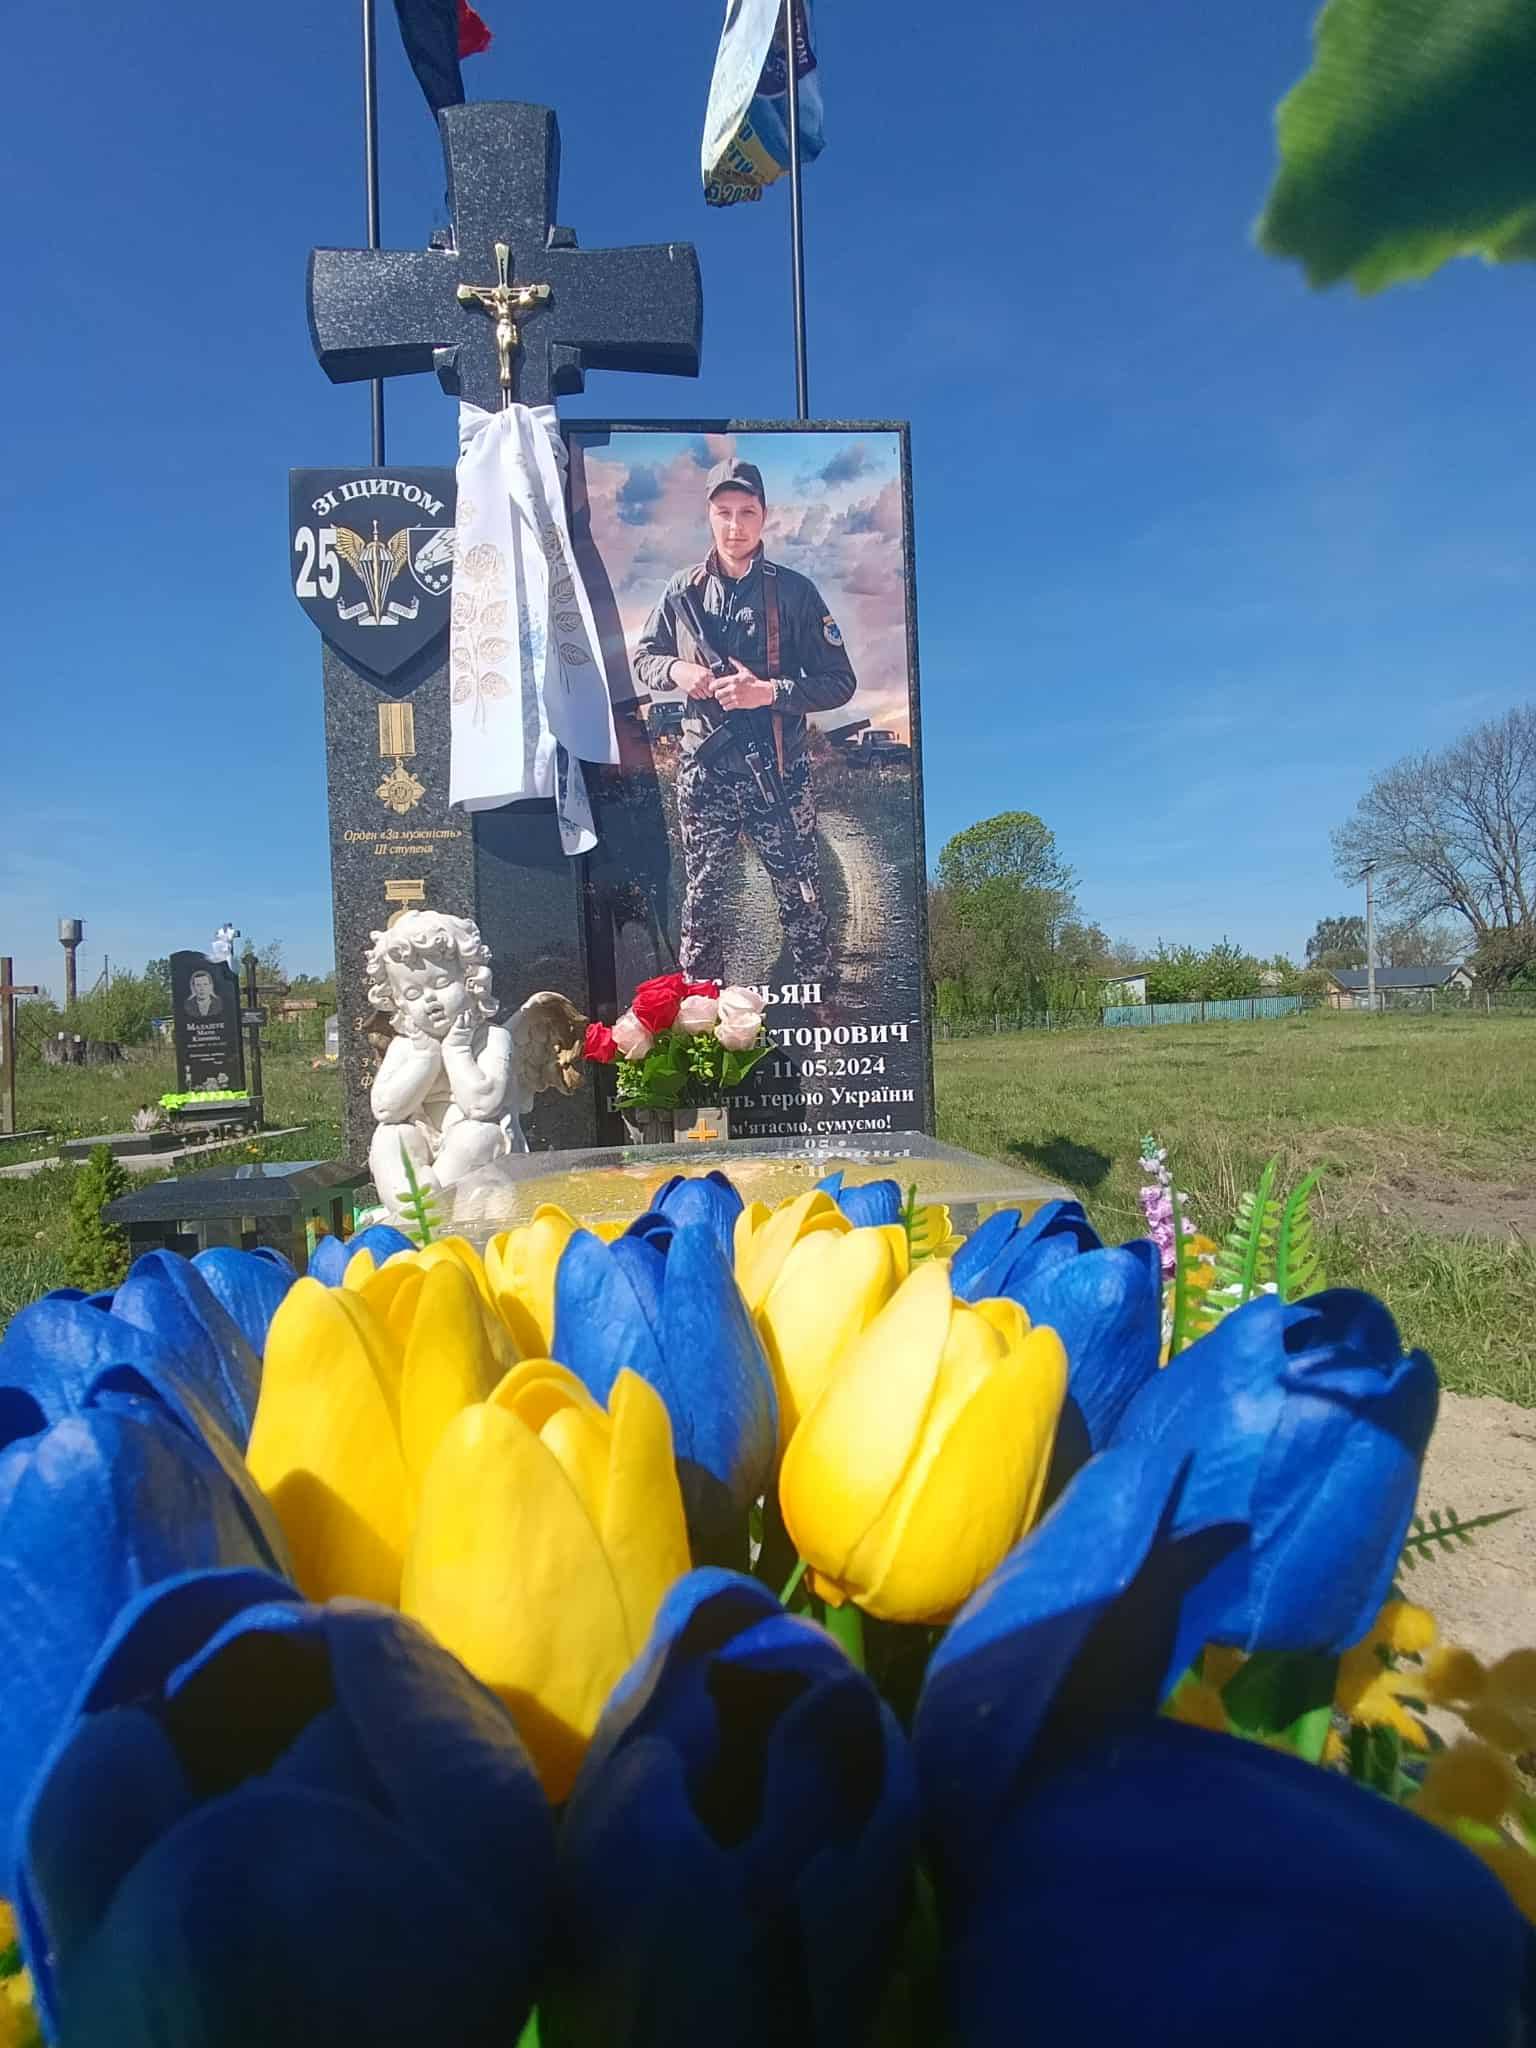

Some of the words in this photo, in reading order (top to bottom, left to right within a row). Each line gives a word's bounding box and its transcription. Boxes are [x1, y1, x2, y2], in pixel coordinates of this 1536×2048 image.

[312, 492, 340, 517] ЗІ
[338, 479, 445, 517] ЩИТОМ
[295, 526, 340, 599] 25
[759, 1024, 909, 1053] кторович
[772, 1056, 886, 1079] 11.05.2024
[760, 1091, 823, 1110] герою
[830, 1086, 915, 1107] України
[816, 1115, 893, 1135] сумуємо!
